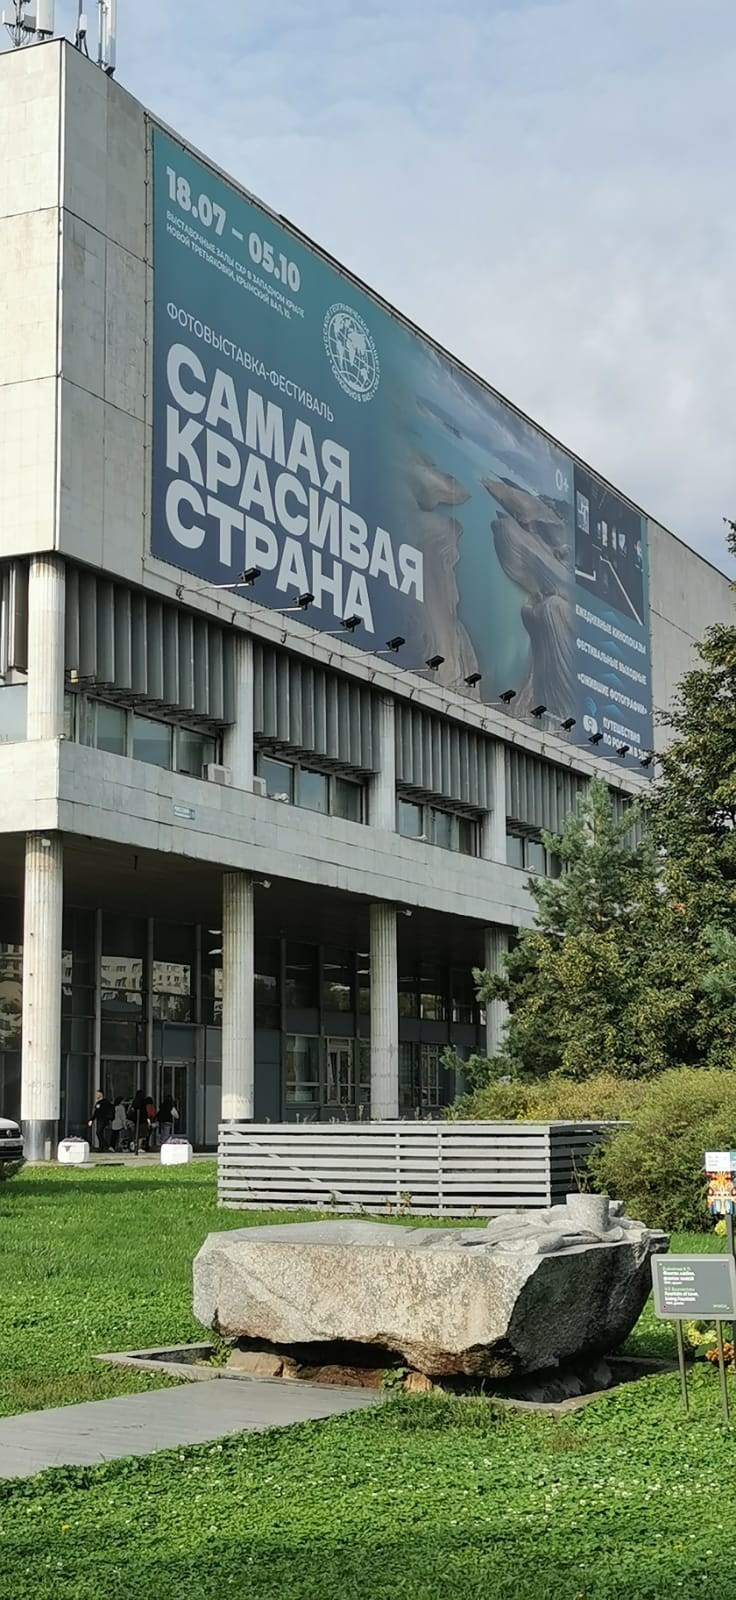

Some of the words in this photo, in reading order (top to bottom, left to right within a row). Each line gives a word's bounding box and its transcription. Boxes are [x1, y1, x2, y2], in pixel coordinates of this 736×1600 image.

[166, 166, 226, 236] 18.07
[249, 232, 300, 292] 05.10
[166, 210, 216, 254] ВЫСТАВОЧНЫЕ
[166, 223, 191, 247] НОВОЙ
[166, 302, 334, 423] ФОТОВЫСТАВКА-ФЕСТИВАЛЬ
[166, 343, 350, 505] САМАЯ
[166, 404, 424, 603] КРАСИВАЯ
[555, 469, 569, 492] 0+
[165, 479, 375, 634] СТРАНА
